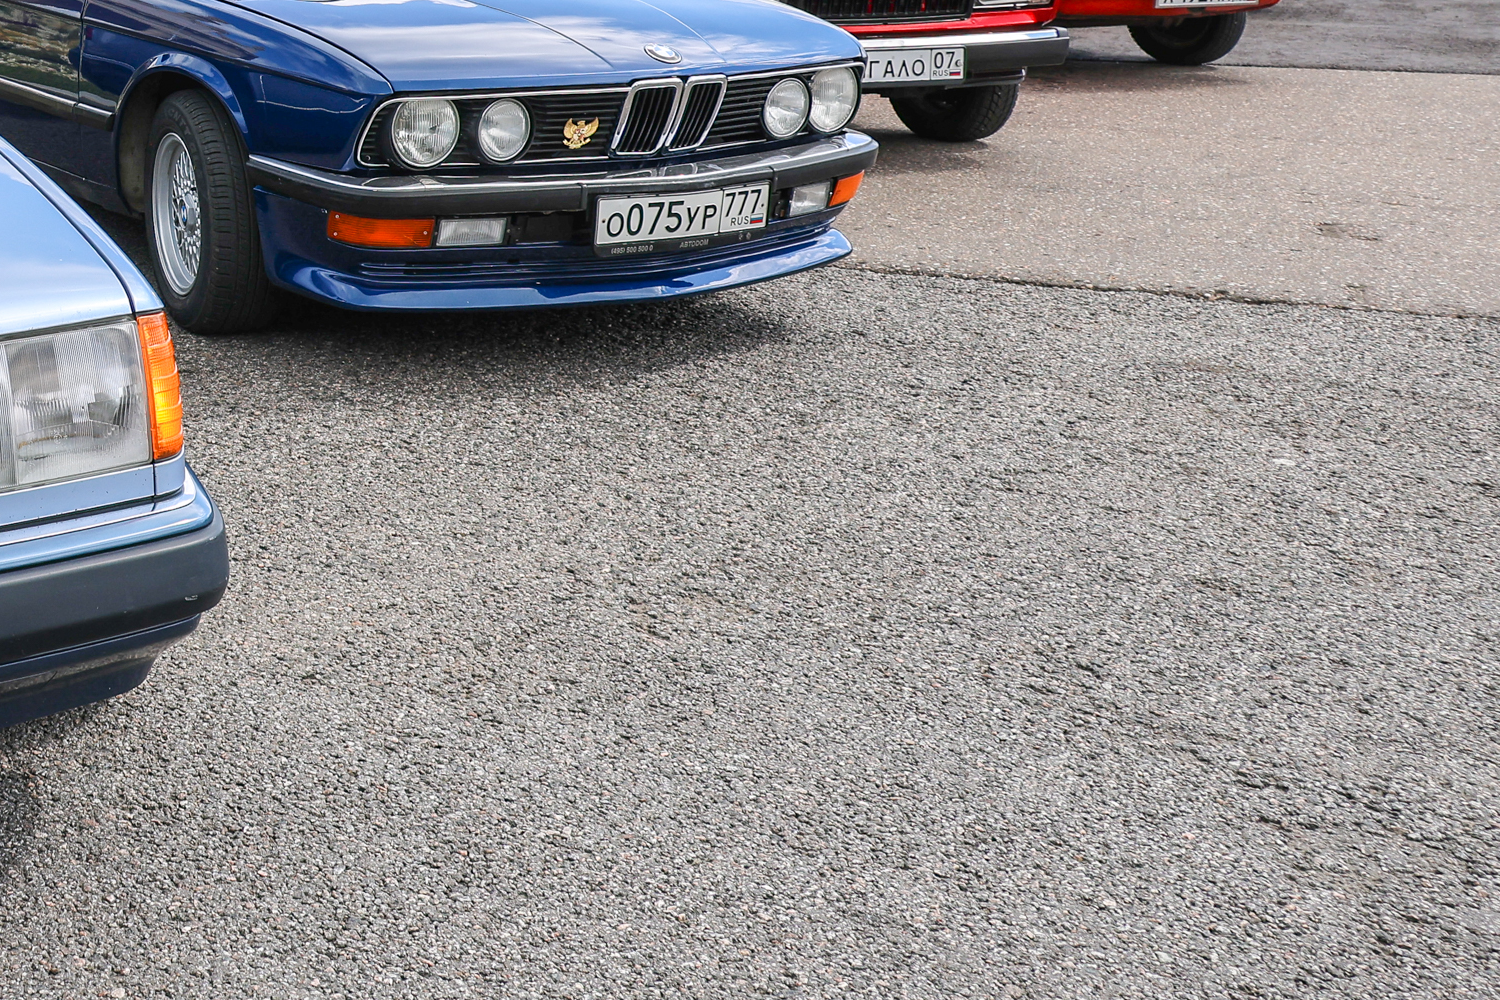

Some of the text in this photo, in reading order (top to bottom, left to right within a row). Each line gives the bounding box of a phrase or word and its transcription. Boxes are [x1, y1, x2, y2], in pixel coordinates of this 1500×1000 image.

[863, 52, 955, 78] ГАЛО 07
[606, 189, 762, 238] О075УР 777
[730, 216, 749, 226] RUS
